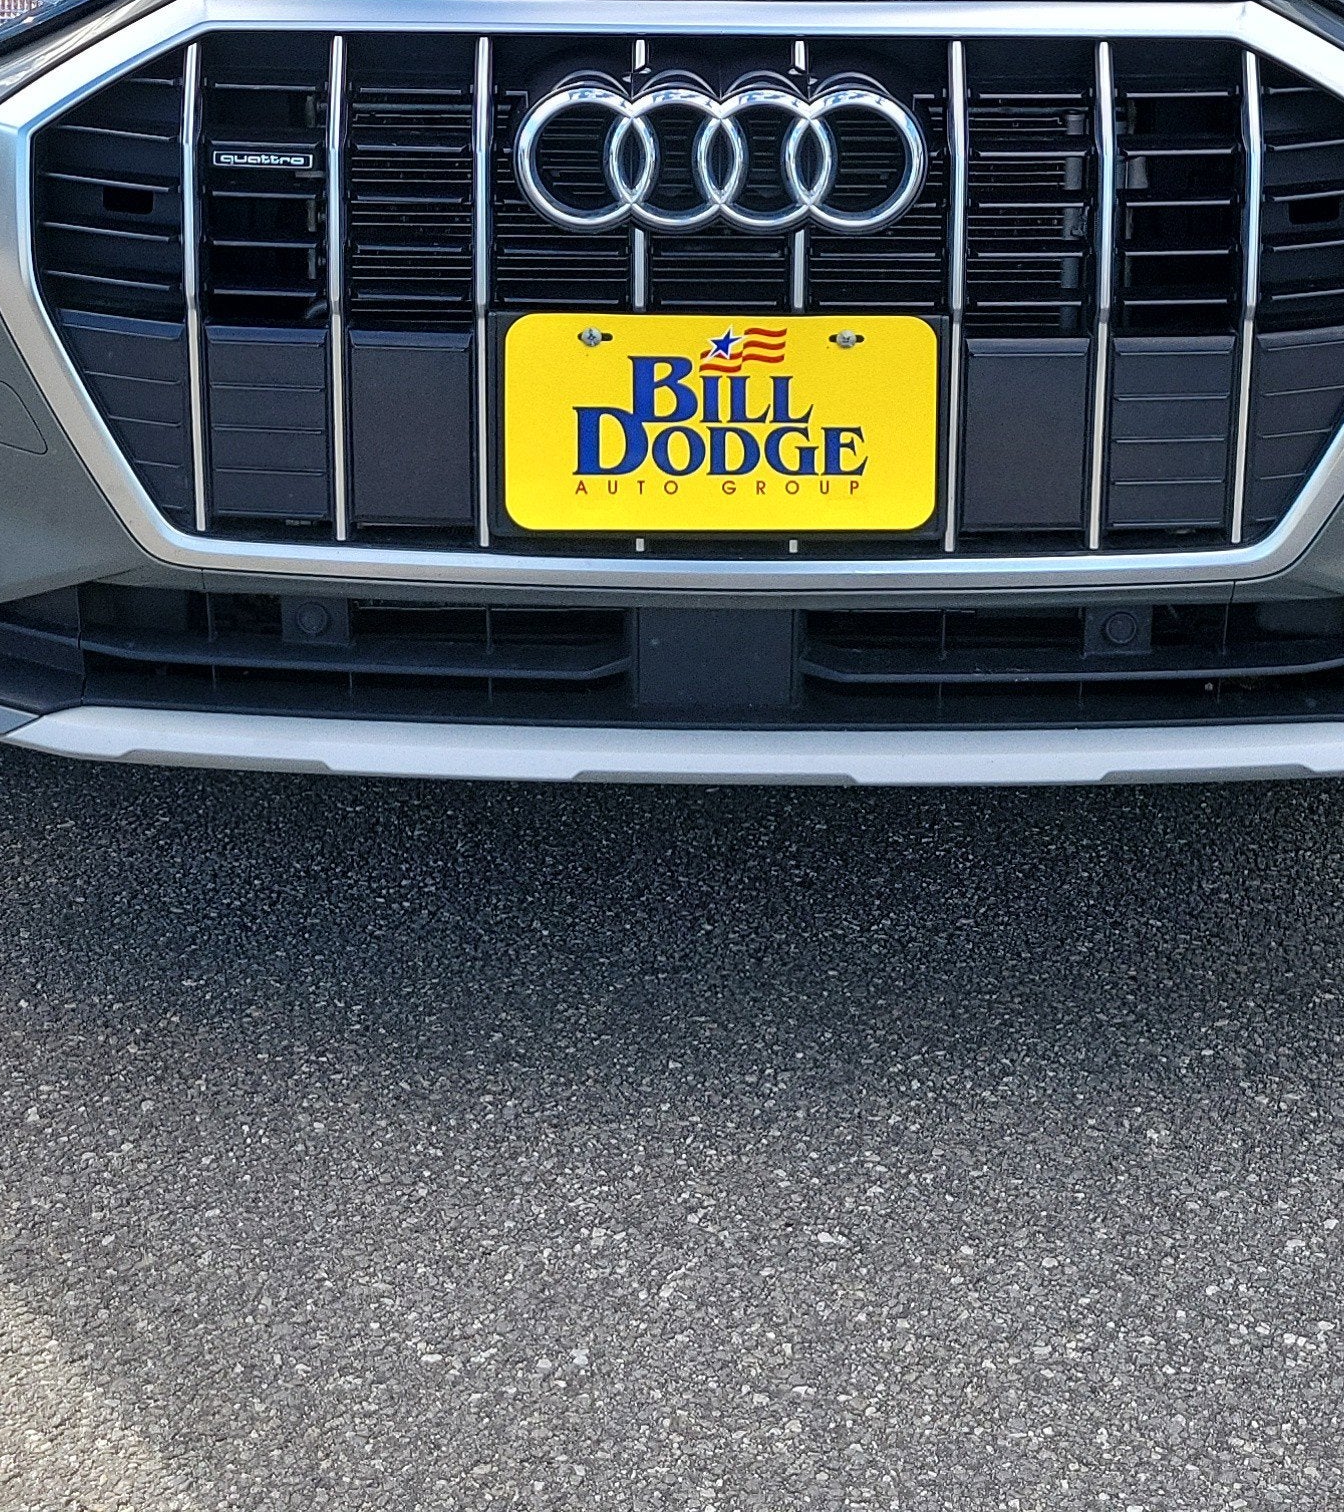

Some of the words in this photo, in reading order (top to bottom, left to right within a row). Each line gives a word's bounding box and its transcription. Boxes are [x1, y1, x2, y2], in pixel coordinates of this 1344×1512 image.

[219, 154, 305, 166] quattro
[627, 355, 814, 424] BILL
[572, 406, 869, 477] DODGE
[574, 480, 680, 496] AUTO
[721, 480, 861, 496] GROUP
